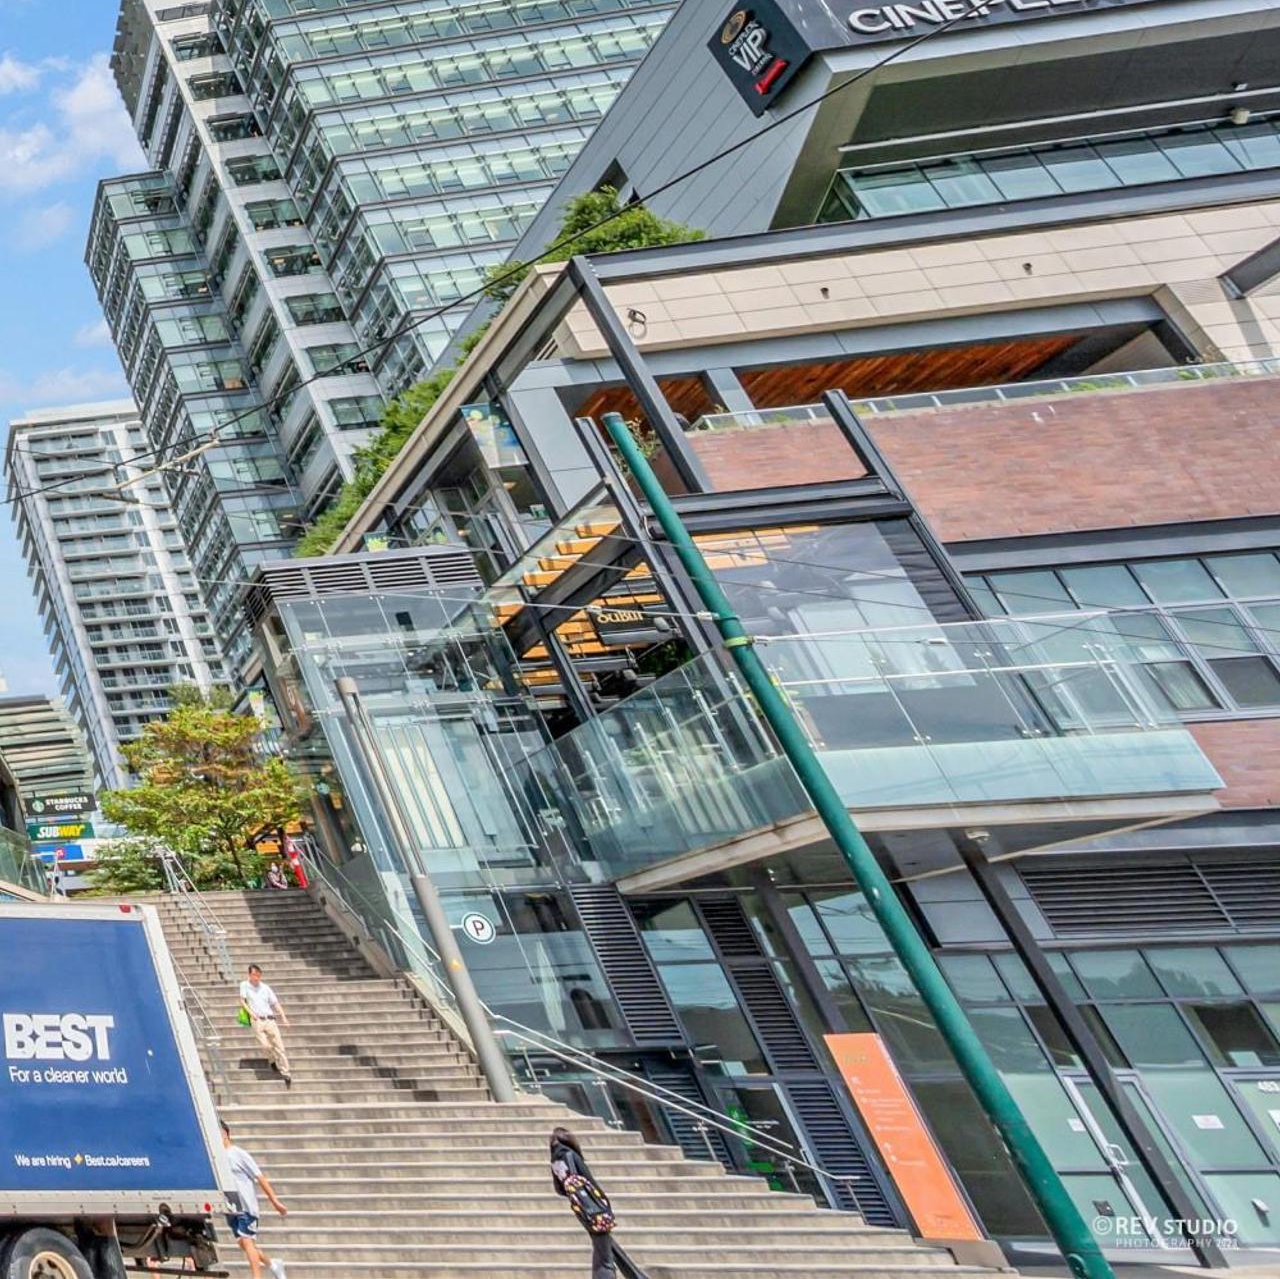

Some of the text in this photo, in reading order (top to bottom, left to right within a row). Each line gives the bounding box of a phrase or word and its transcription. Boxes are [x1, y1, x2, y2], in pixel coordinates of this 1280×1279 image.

[732, 27, 767, 71] VIP
[45, 796, 89, 805] STARBUCKS
[54, 803, 82, 811] COFFEE
[37, 824, 85, 838] SUBWAY
[3, 1013, 115, 1061] BEST
[8, 1065, 129, 1083] For a cleaner world
[14, 1154, 150, 1169] We are hiring Best.ca/careers
